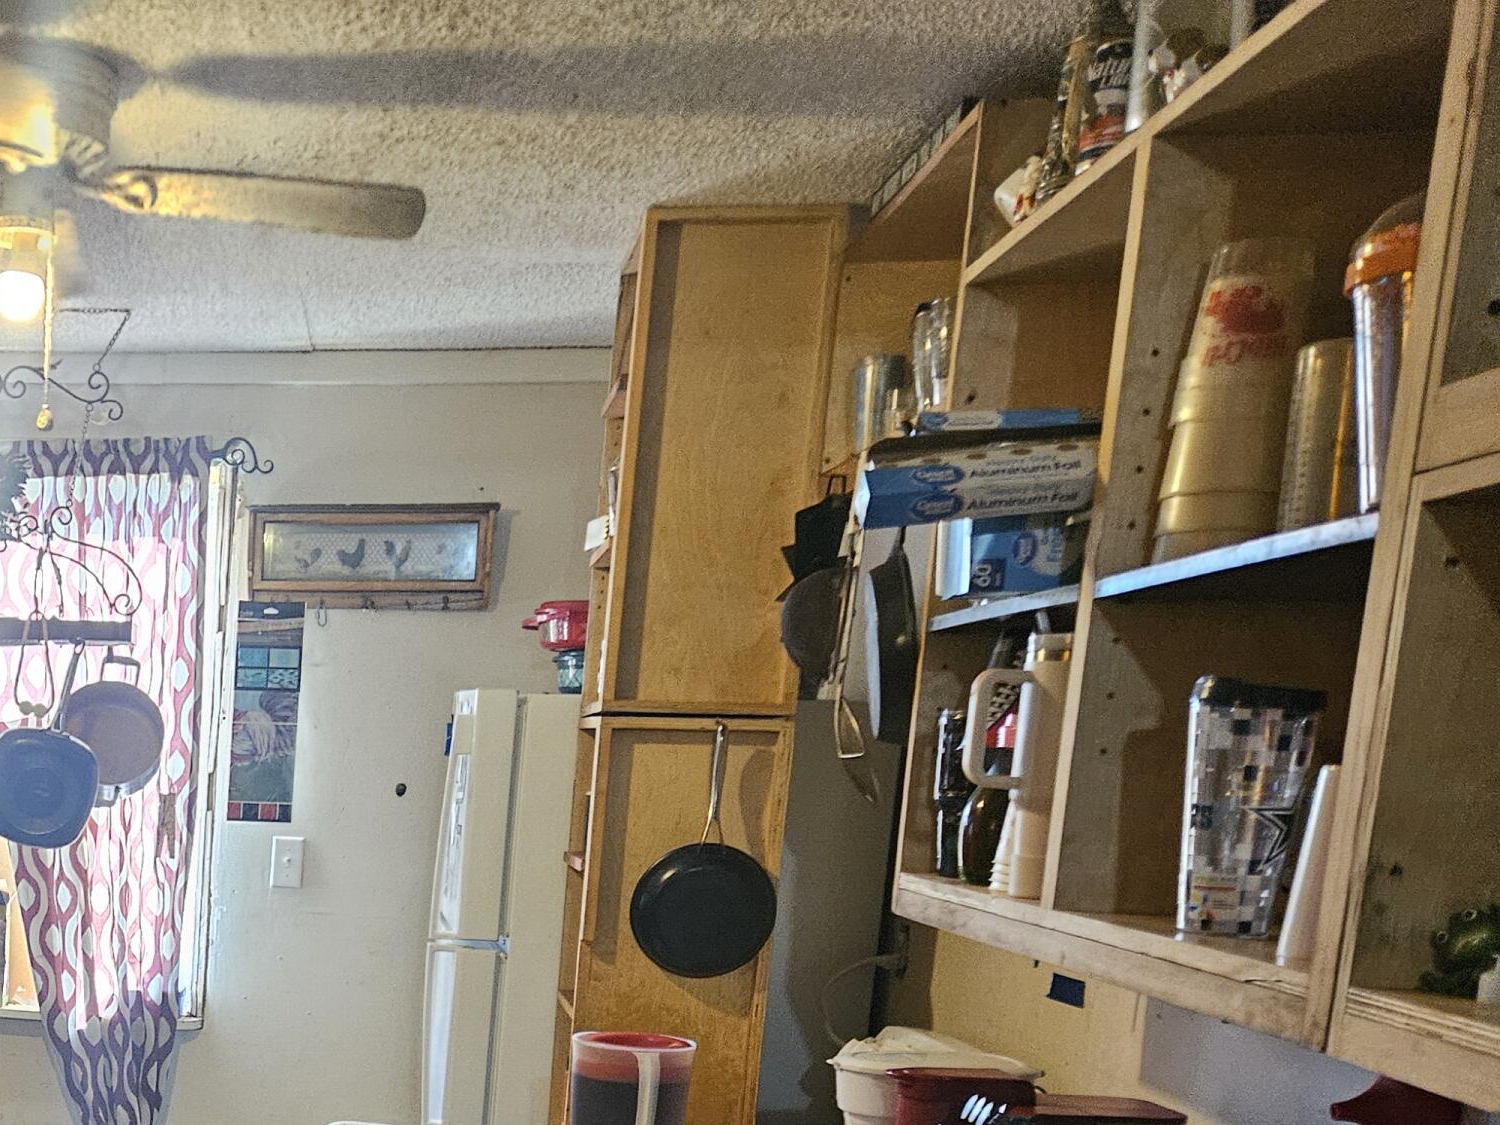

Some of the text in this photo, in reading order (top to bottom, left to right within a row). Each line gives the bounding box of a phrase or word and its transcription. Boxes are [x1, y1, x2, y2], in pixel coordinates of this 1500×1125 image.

[969, 463, 1051, 478] Aluminum
[1053, 460, 1083, 472] Foil
[967, 494, 1049, 510] Aluminum
[1049, 492, 1079, 505] Foil
